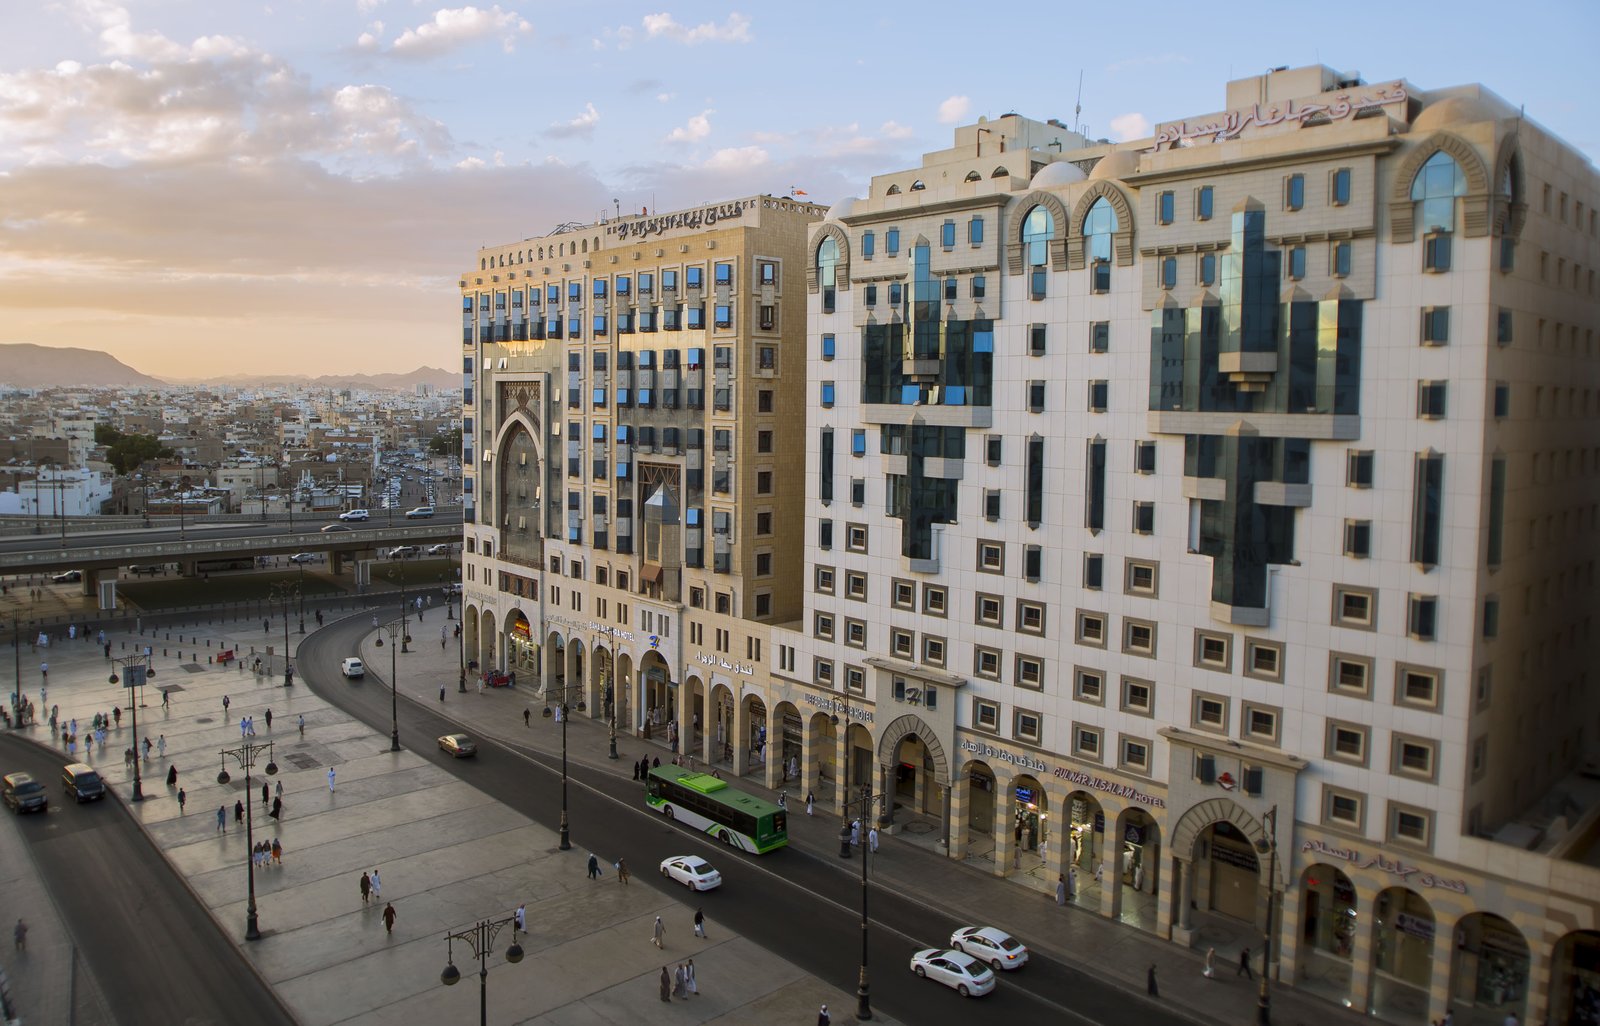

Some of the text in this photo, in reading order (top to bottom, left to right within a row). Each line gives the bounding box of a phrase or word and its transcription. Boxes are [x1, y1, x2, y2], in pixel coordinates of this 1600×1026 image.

[1153, 83, 1408, 152] فندق جلنار السلام
[620, 630, 636, 642] HOTEL
[695, 651, 717, 666] الزهراء
[734, 660, 754, 676] فندق
[855, 707, 874, 723] HOTEL
[1053, 766, 1089, 787] GULNAR
[1135, 794, 1165, 809] HOTEL
[1302, 839, 1467, 894] فندق جلنار السلام
